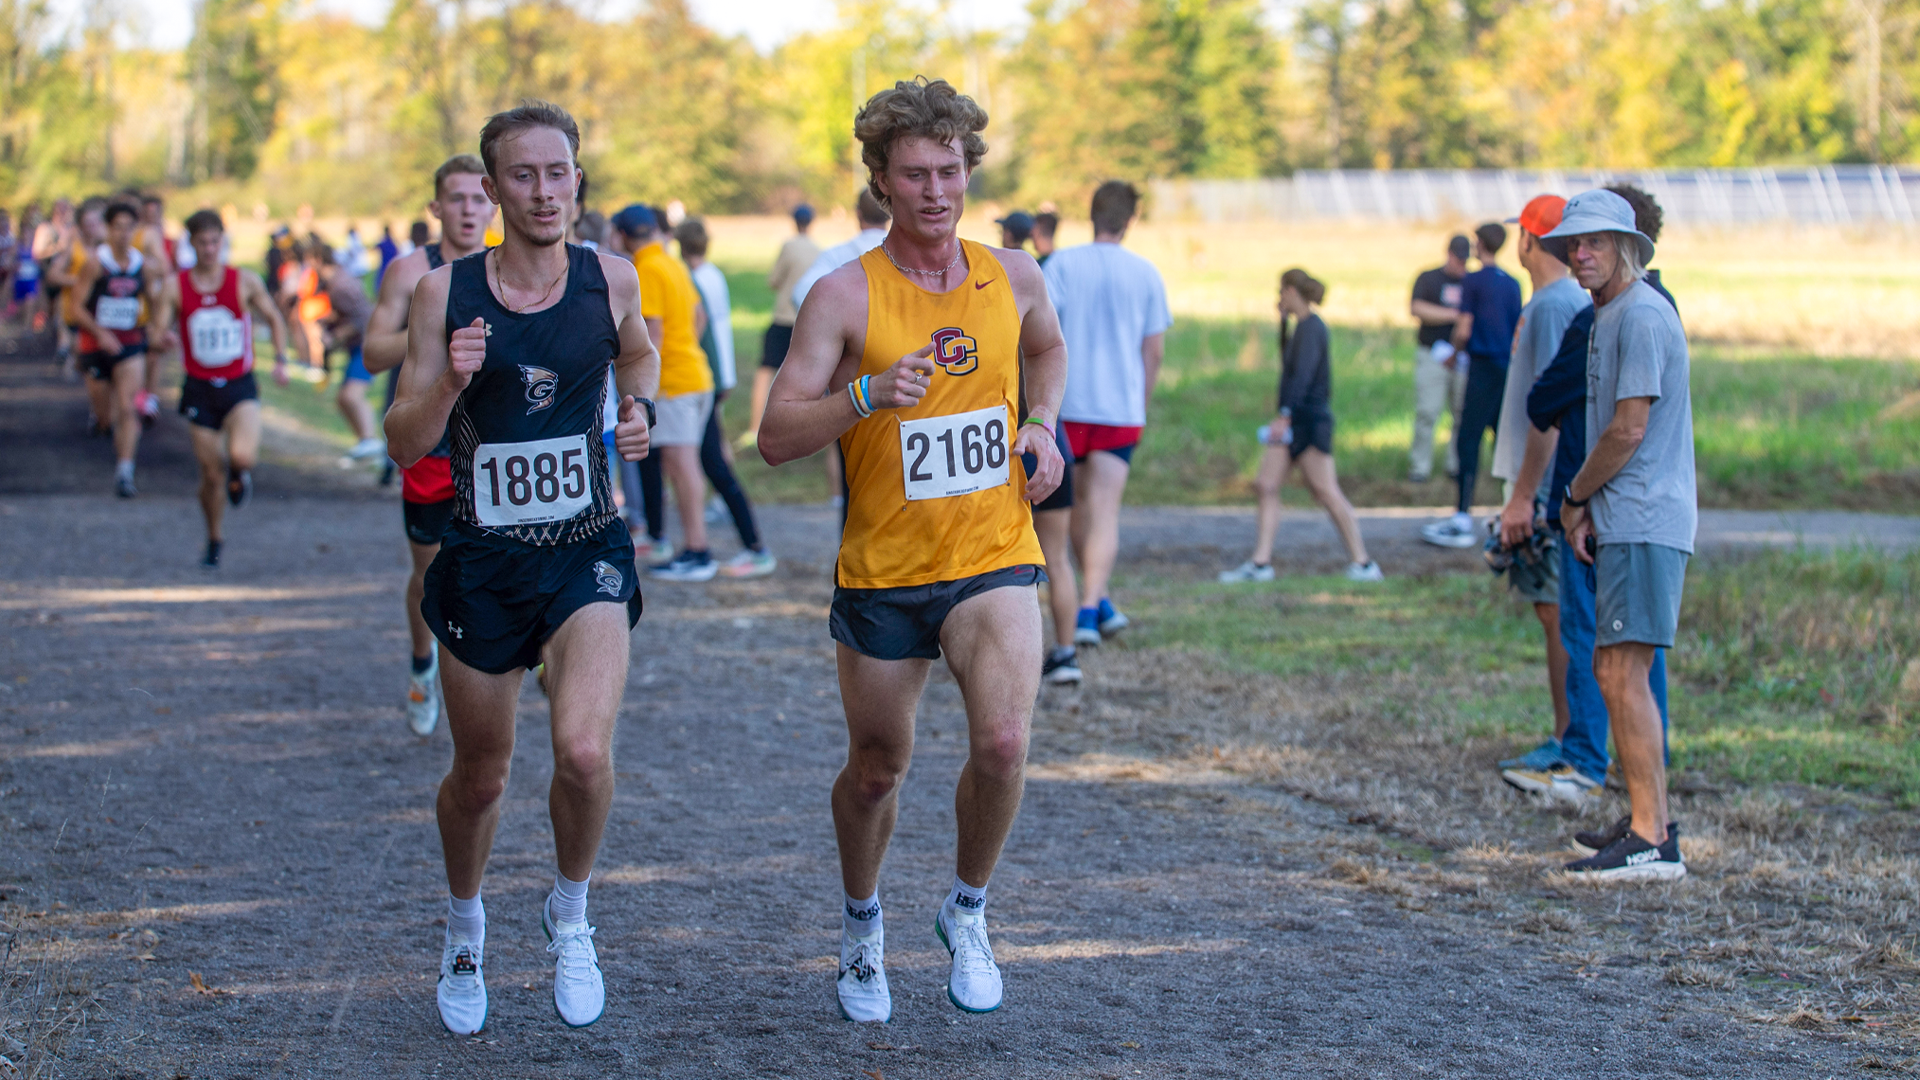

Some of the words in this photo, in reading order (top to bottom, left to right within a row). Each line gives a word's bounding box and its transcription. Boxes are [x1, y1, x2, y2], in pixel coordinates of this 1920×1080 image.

[480, 447, 586, 507] 1885
[906, 418, 1006, 483] 2168
[1625, 847, 1662, 866] HOKA
